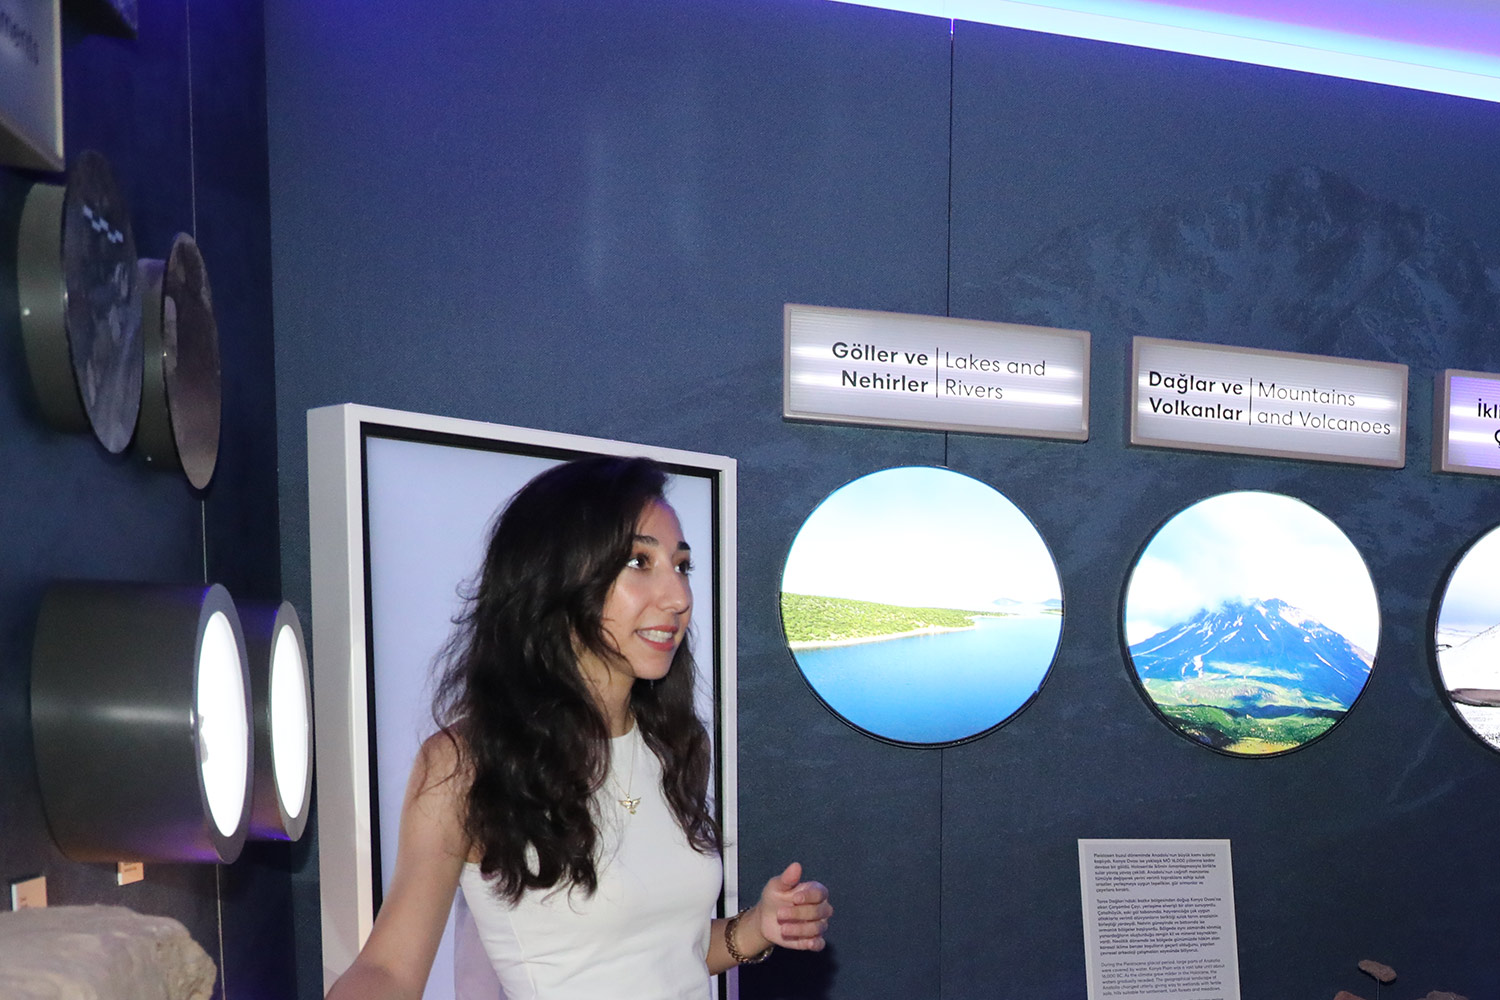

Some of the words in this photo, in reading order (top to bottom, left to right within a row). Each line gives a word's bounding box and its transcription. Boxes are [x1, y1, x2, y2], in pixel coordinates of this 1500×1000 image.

[832, 342, 898, 364] Göller
[904, 352, 929, 367] ve
[945, 351, 1001, 373] Lakes
[1006, 359, 1047, 377] and
[841, 370, 929, 394] Nehirler
[945, 378, 1004, 400] Rivers
[1149, 371, 1216, 396] Dağlar
[1220, 381, 1244, 396] ve
[1258, 382, 1355, 407] Mountains
[1149, 396, 1243, 422] Volkanlar
[1257, 409, 1294, 427] and
[1299, 410, 1391, 436] Volcanoes
